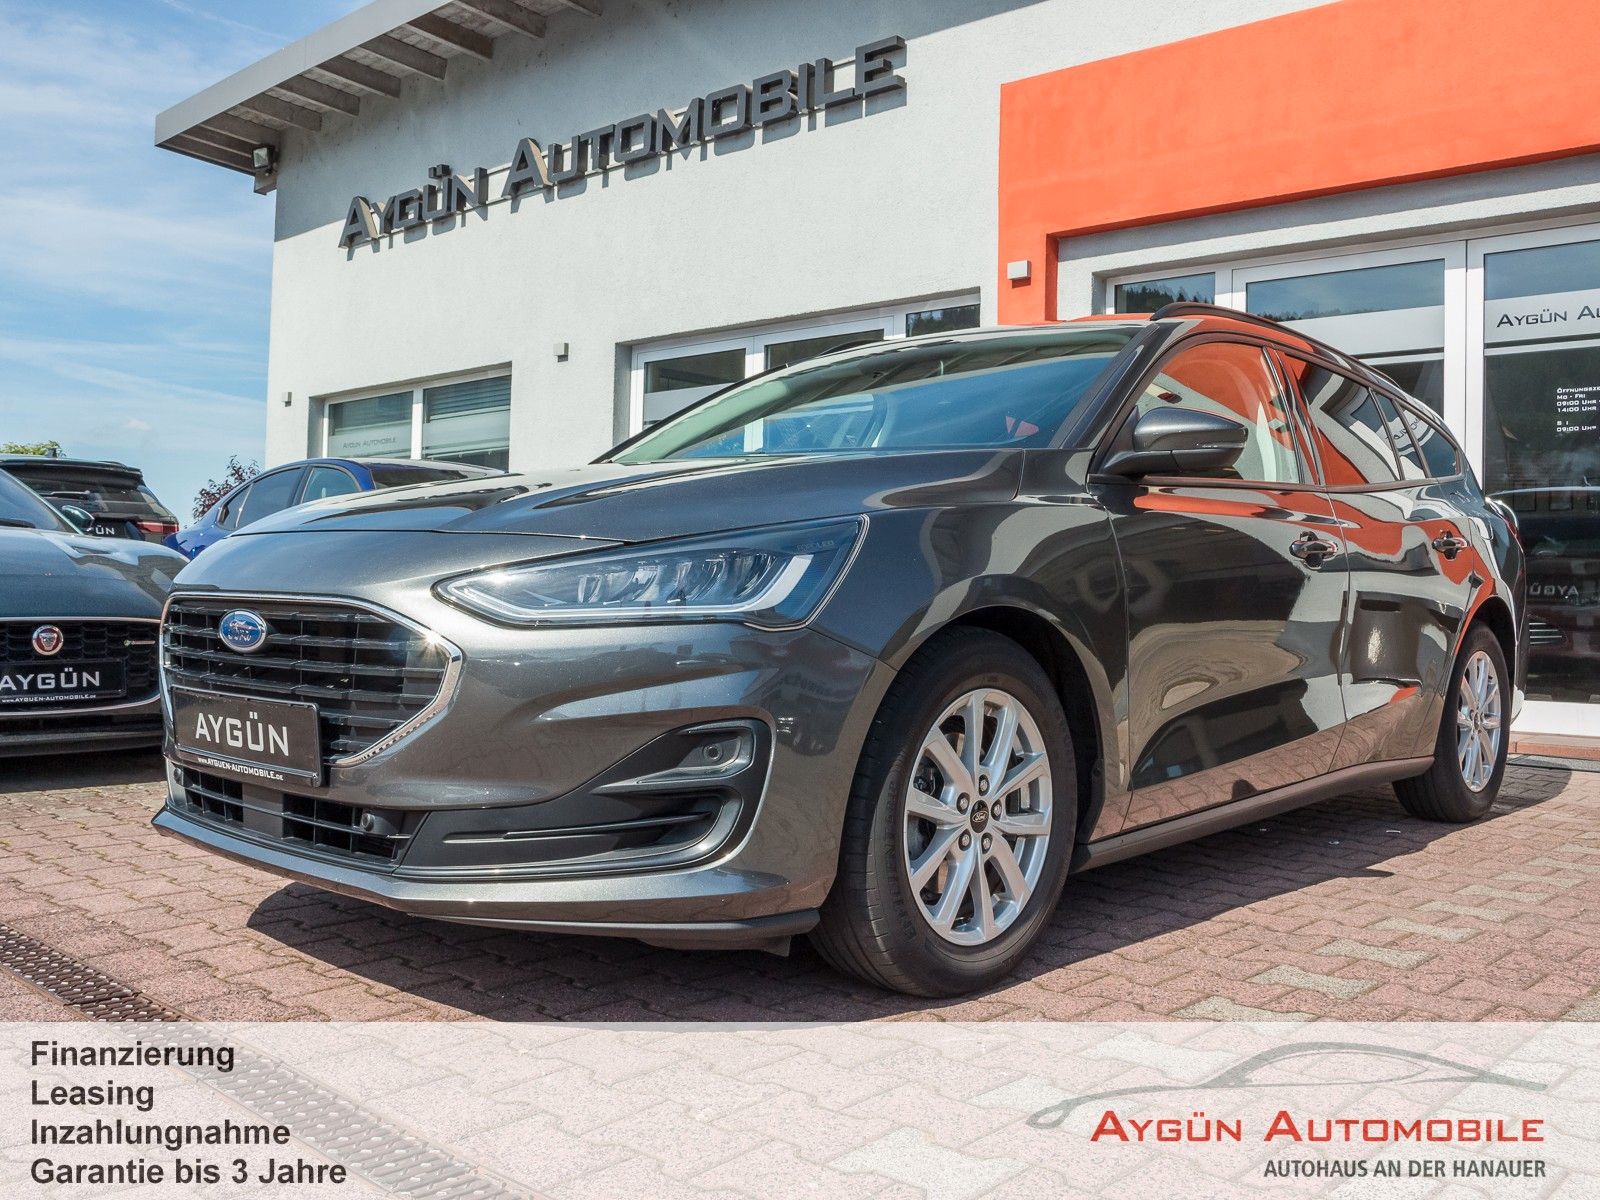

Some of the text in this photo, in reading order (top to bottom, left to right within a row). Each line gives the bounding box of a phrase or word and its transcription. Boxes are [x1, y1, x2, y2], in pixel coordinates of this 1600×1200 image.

[337, 35, 907, 249] AYGÜN AUTOMOBILE
[1496, 308, 1567, 327] AYGÜN
[0, 667, 100, 691] AYGÜN
[195, 711, 289, 757] AYGÜN
